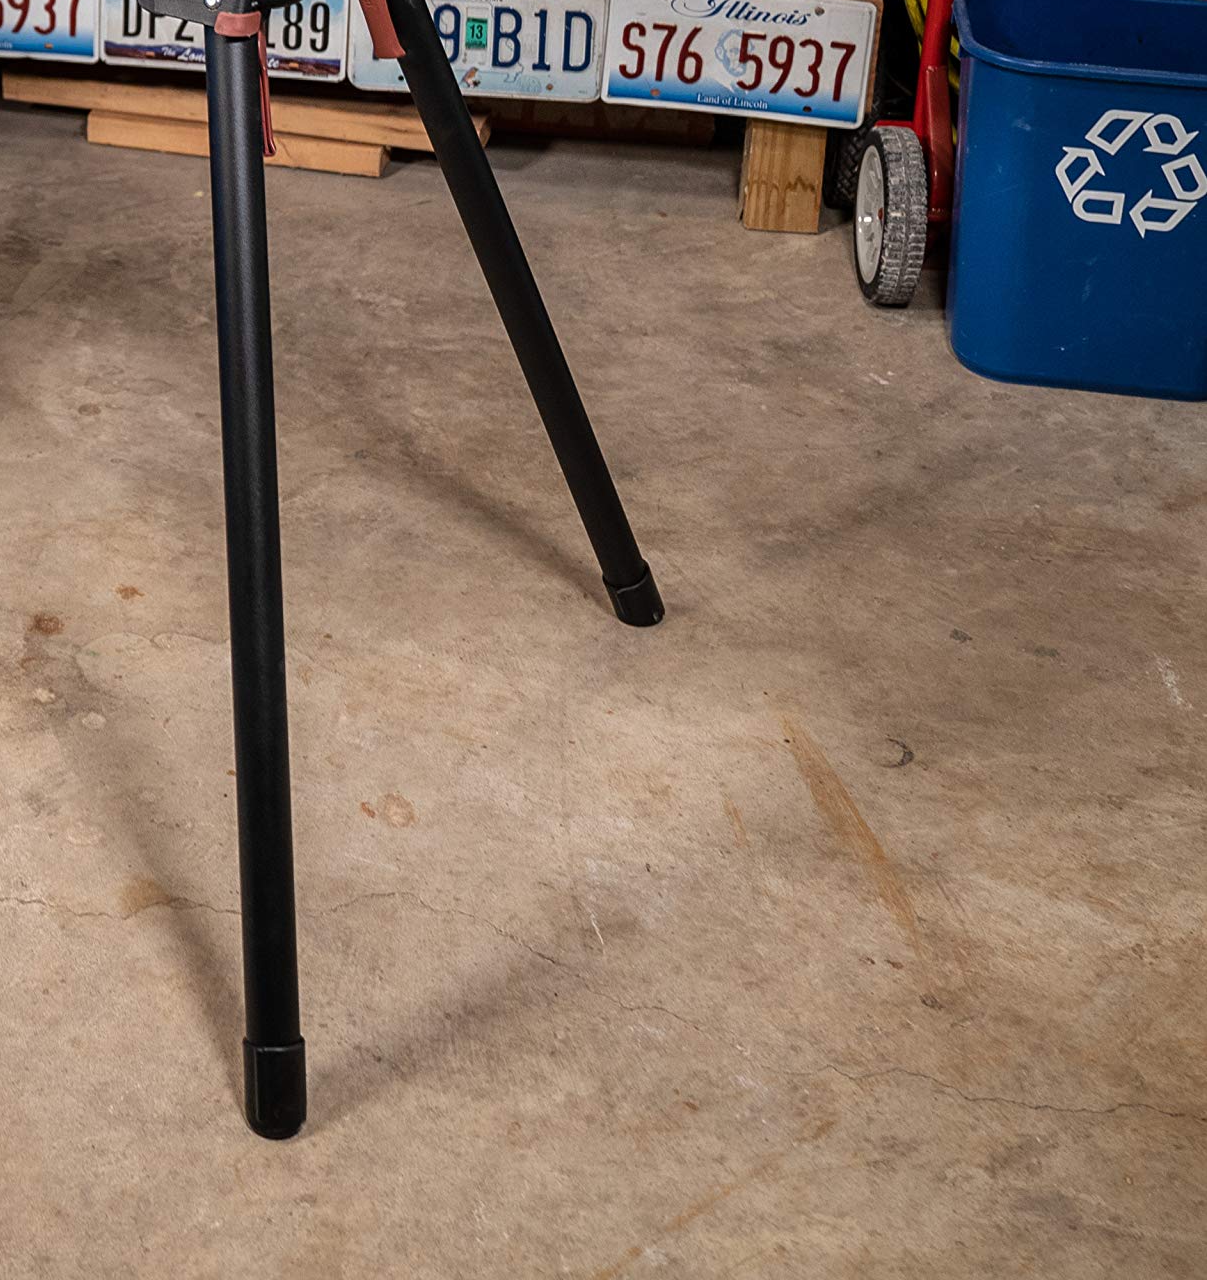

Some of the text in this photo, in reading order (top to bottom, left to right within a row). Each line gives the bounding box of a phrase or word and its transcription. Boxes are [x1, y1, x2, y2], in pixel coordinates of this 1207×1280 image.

[469, 24, 484, 40] 13
[491, 6, 593, 73] B1D
[618, 22, 857, 102] S76 5937
[697, 93, 768, 110] Land of Lincoln
